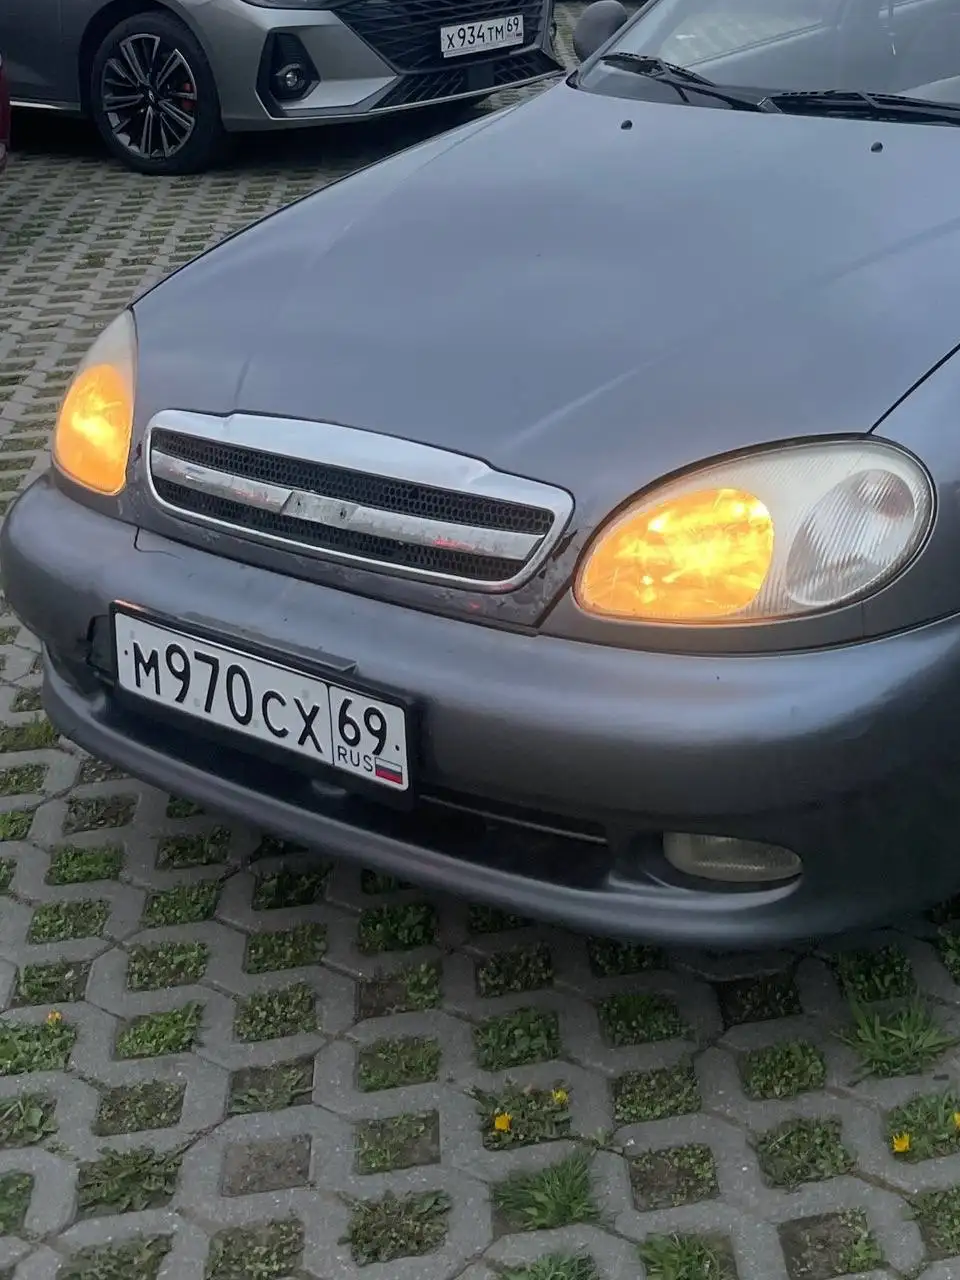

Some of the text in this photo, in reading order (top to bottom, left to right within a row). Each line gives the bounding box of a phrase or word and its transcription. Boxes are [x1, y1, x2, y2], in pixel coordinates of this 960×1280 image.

[133, 641, 389, 755] М970СХ 69
[337, 745, 374, 773] RUS
